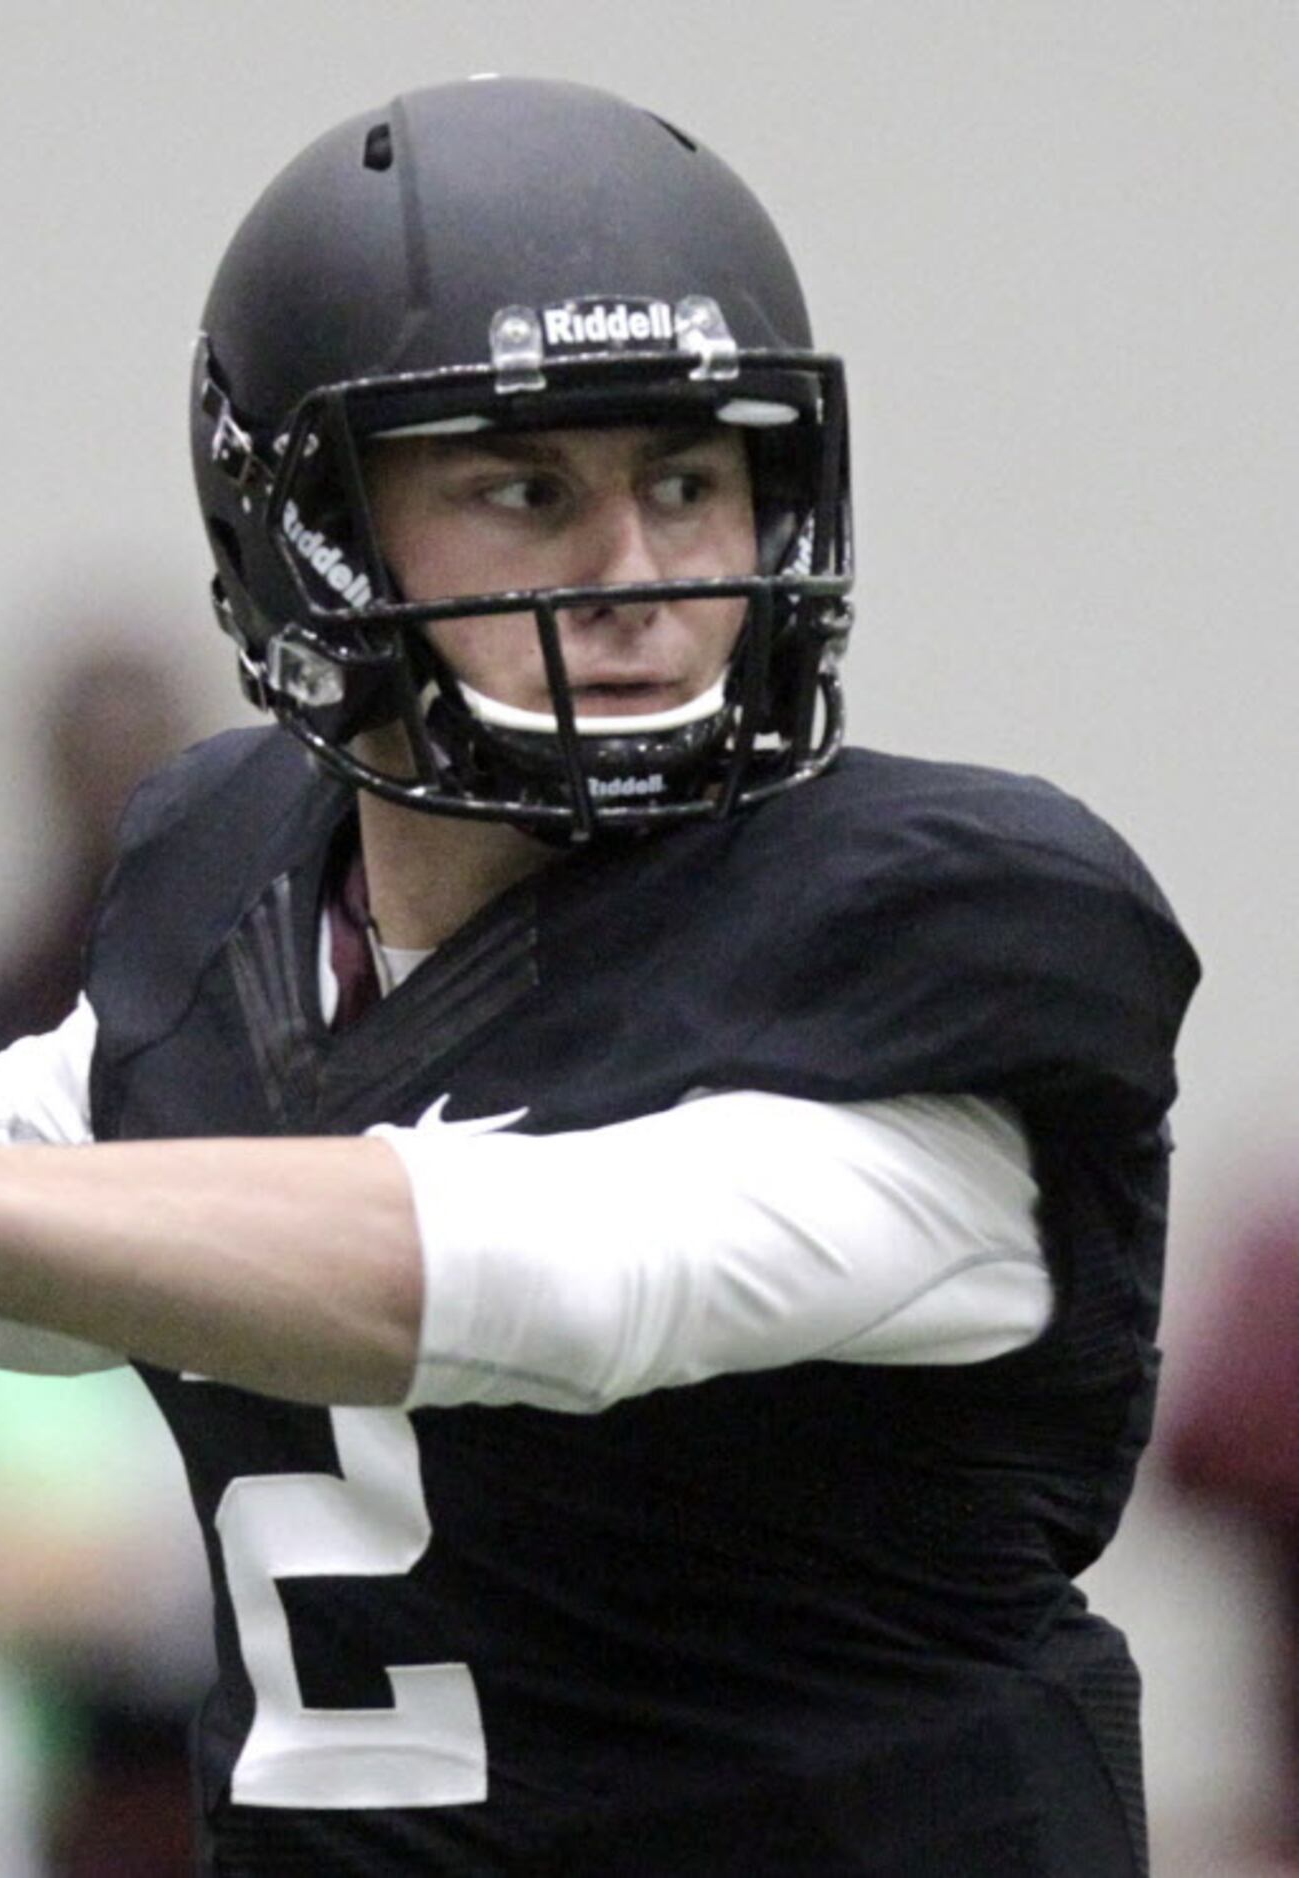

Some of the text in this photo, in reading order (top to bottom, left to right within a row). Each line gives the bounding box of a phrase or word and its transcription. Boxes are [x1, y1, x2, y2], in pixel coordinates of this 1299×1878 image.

[544, 301, 675, 346] Riddell
[282, 498, 372, 609] Riddell
[214, 1404, 488, 1811] 2
